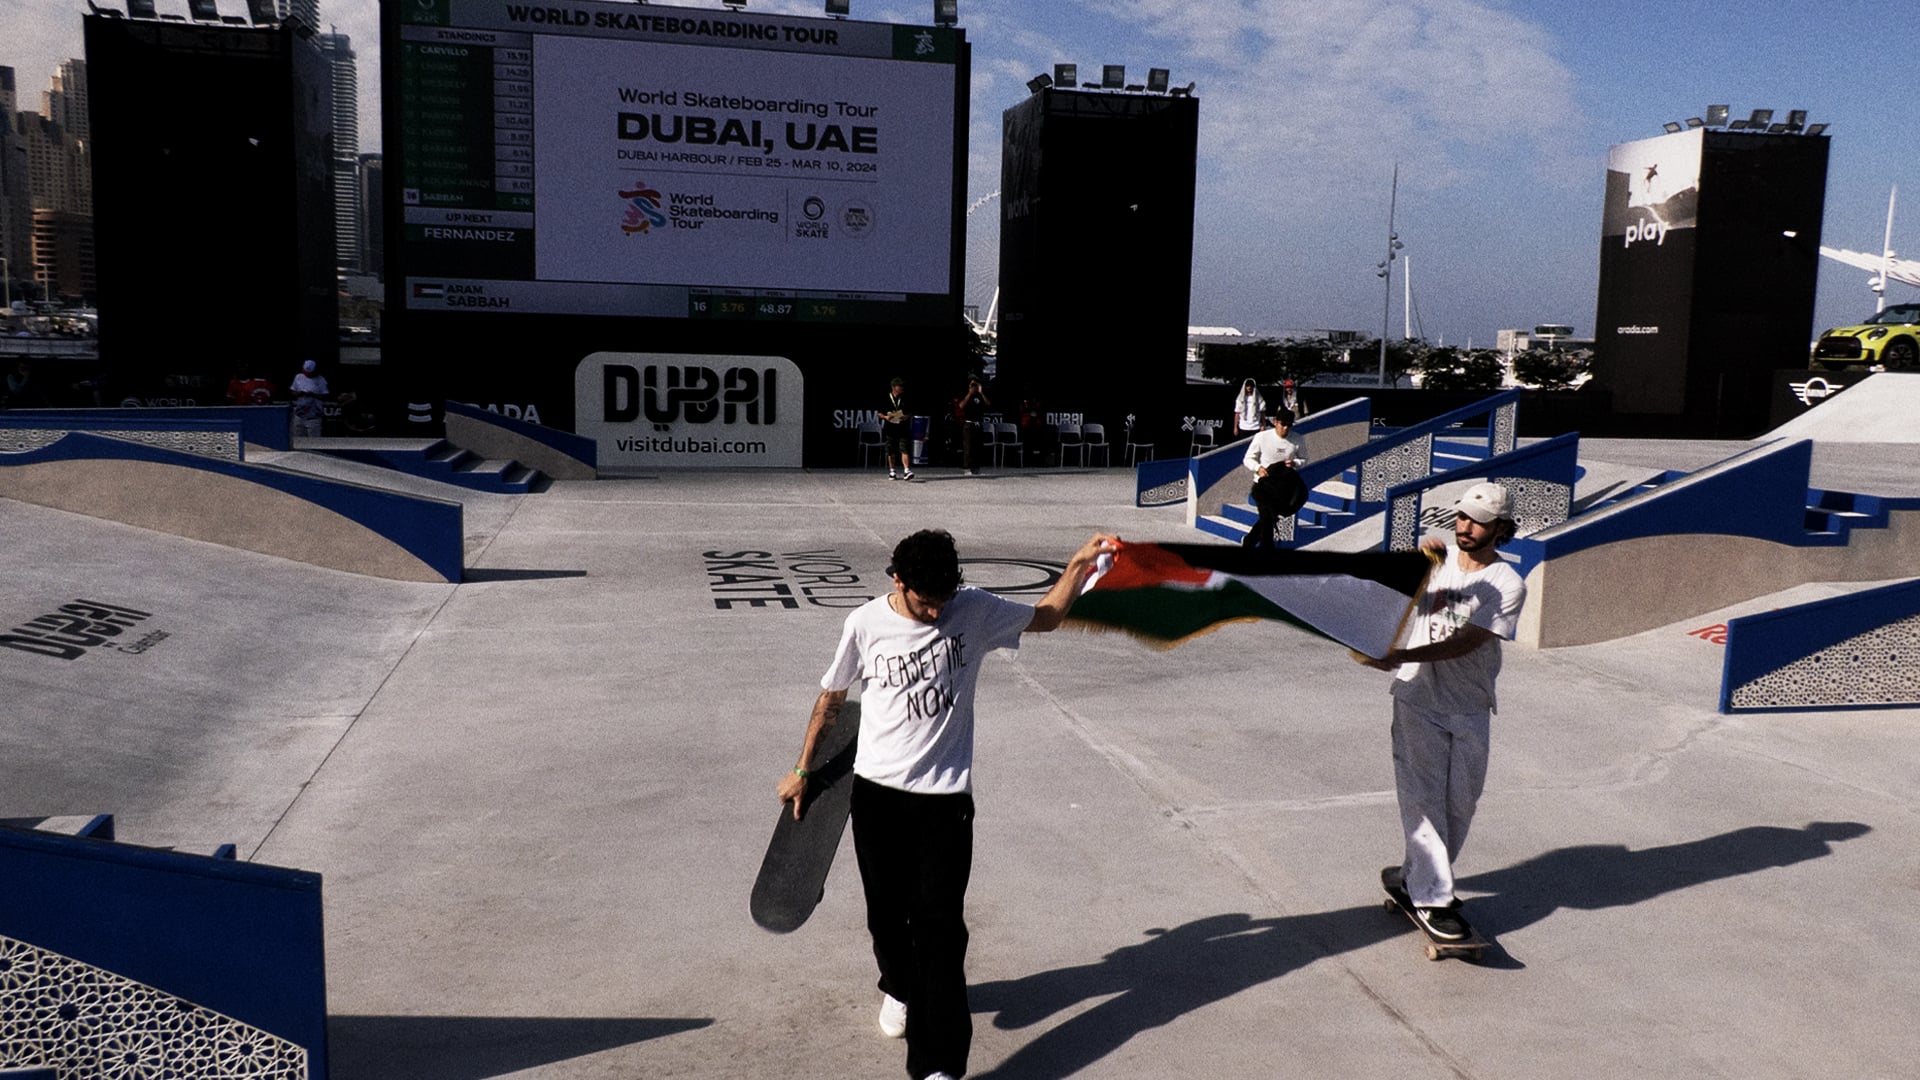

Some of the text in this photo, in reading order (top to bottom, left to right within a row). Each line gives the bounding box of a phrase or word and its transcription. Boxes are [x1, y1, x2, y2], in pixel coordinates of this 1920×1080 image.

[507, 5, 838, 46] WORLD SKATEBOARDING TOUR
[438, 30, 497, 42] STANDINGS
[419, 45, 469, 57] CARVILLO
[618, 87, 878, 118] World Skateboarding Tour
[617, 111, 878, 155] DUBAI, UAE
[617, 149, 658, 161] DUBAI
[661, 151, 727, 166] HARBOUR
[738, 156, 763, 167] FEB
[766, 158, 782, 168] 25
[792, 159, 821, 170] MAR
[827, 161, 843, 173] 10,
[847, 162, 878, 173] 2024
[669, 192, 714, 206] World
[446, 213, 493, 224] UP NEXT
[669, 205, 779, 224] Skateboarding
[669, 217, 704, 230] Tour
[796, 221, 830, 230] WORLD
[423, 226, 516, 242] FERNANDEZ
[796, 229, 829, 239] SKATE
[1624, 217, 1670, 249] play
[446, 284, 484, 295] ARAM
[447, 295, 510, 308] SABBAH
[693, 301, 707, 312] 16
[721, 302, 745, 313] 3.76
[759, 303, 792, 315] 48.87
[1616, 324, 1659, 335] arada.com
[603, 364, 777, 430] DUBAI
[615, 437, 766, 454] visitdubai.com
[702, 550, 800, 610] SKATE
[875, 633, 967, 688] CEASEFIRE
[907, 680, 955, 721] NOW
